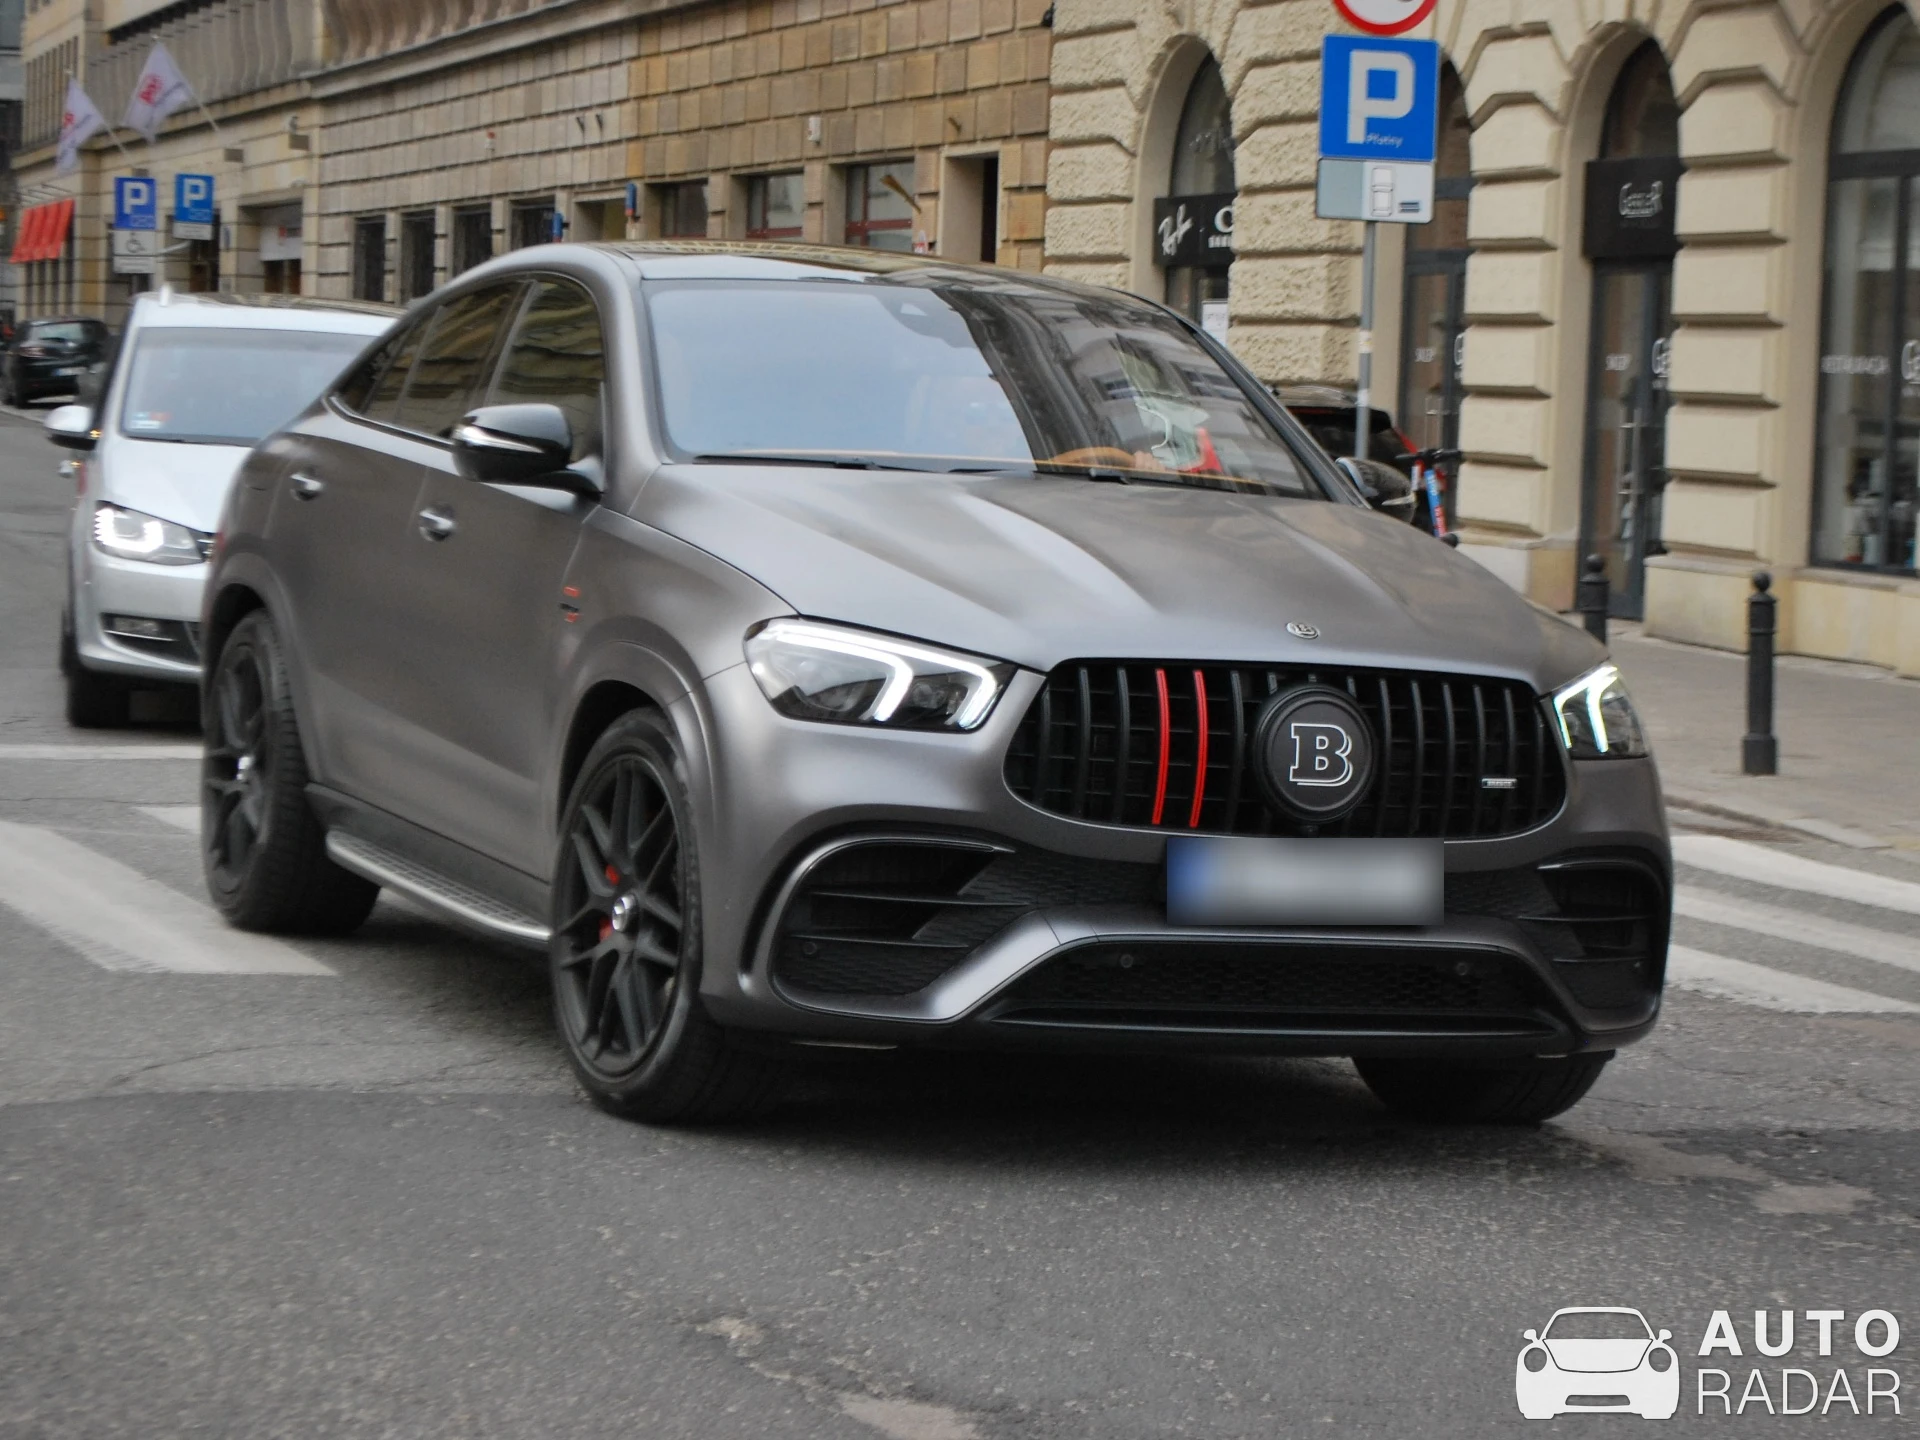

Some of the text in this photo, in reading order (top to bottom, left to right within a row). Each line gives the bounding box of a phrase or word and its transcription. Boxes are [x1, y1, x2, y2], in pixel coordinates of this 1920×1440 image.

[1347, 49, 1416, 144] P
[124, 181, 149, 214] P
[183, 178, 207, 208] P
[1289, 722, 1353, 787] B
